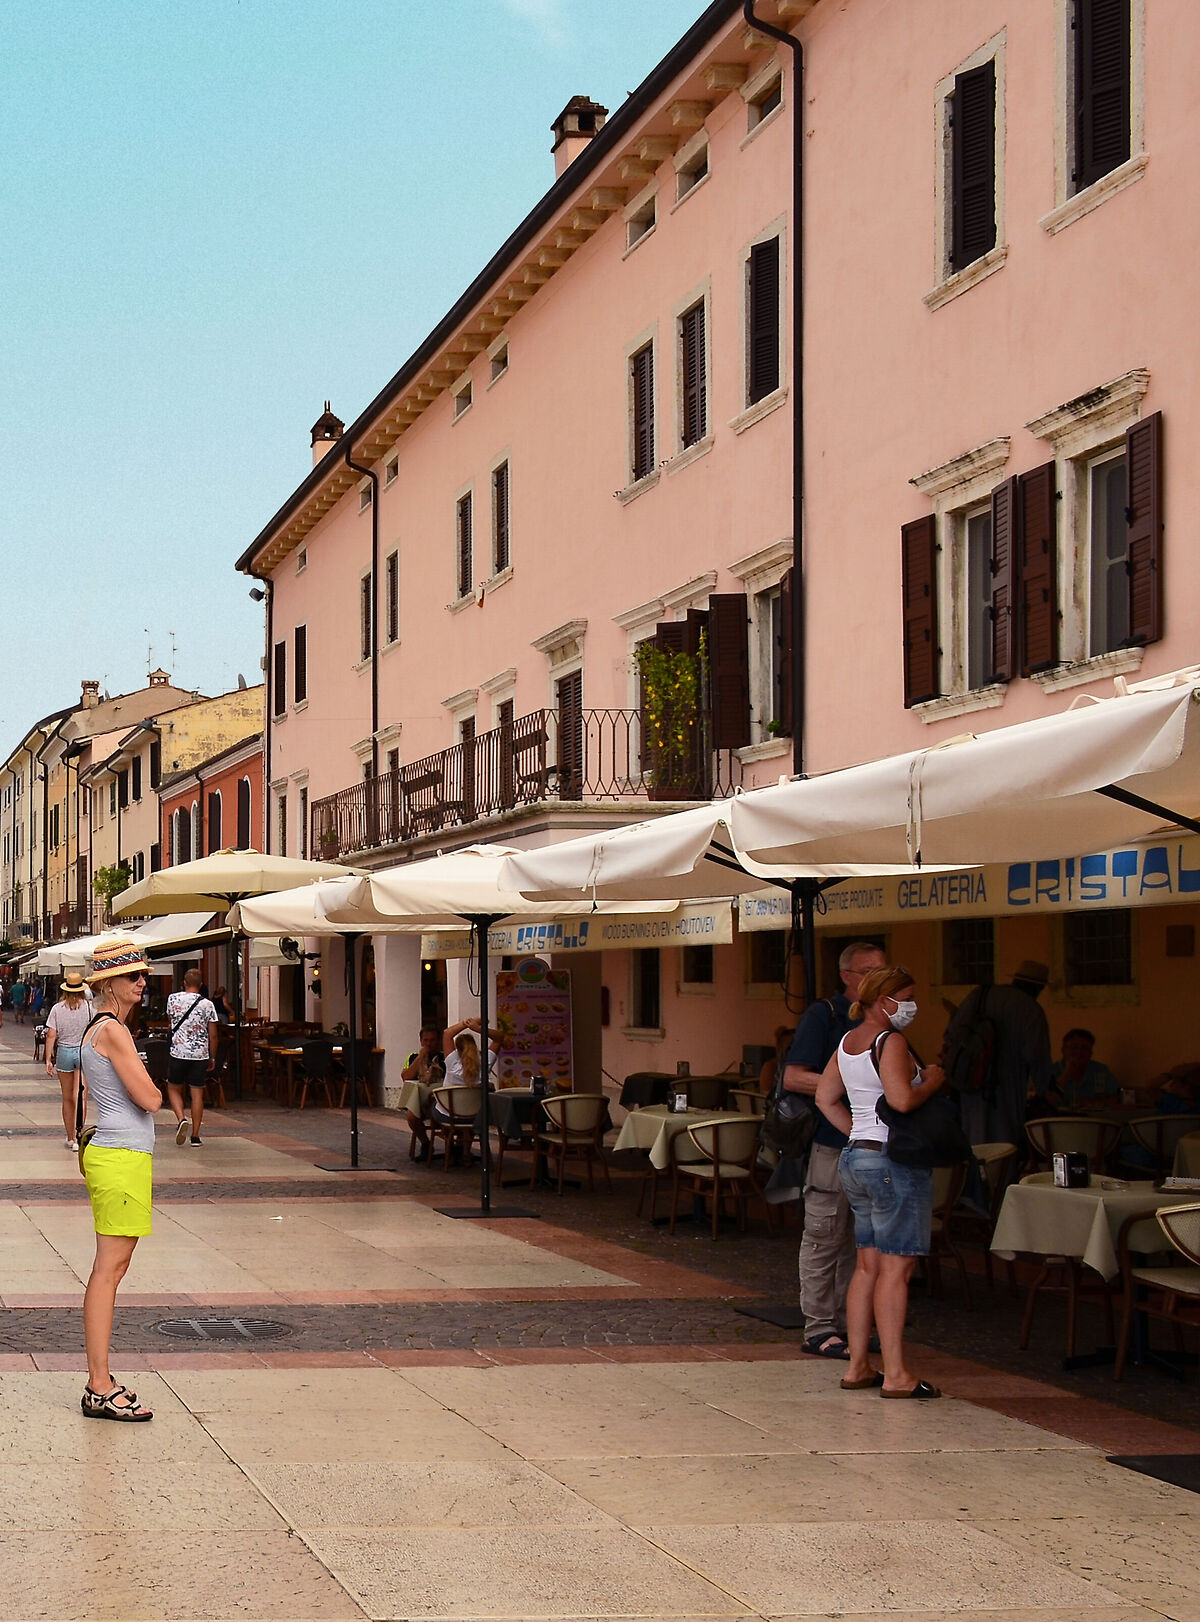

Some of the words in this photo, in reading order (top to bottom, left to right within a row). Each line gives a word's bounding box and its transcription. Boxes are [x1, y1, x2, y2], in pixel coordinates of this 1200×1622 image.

[897, 873, 987, 909] GELATERIA
[516, 921, 589, 951] CRISTALLO
[675, 915, 716, 935] HOUTOVEN
